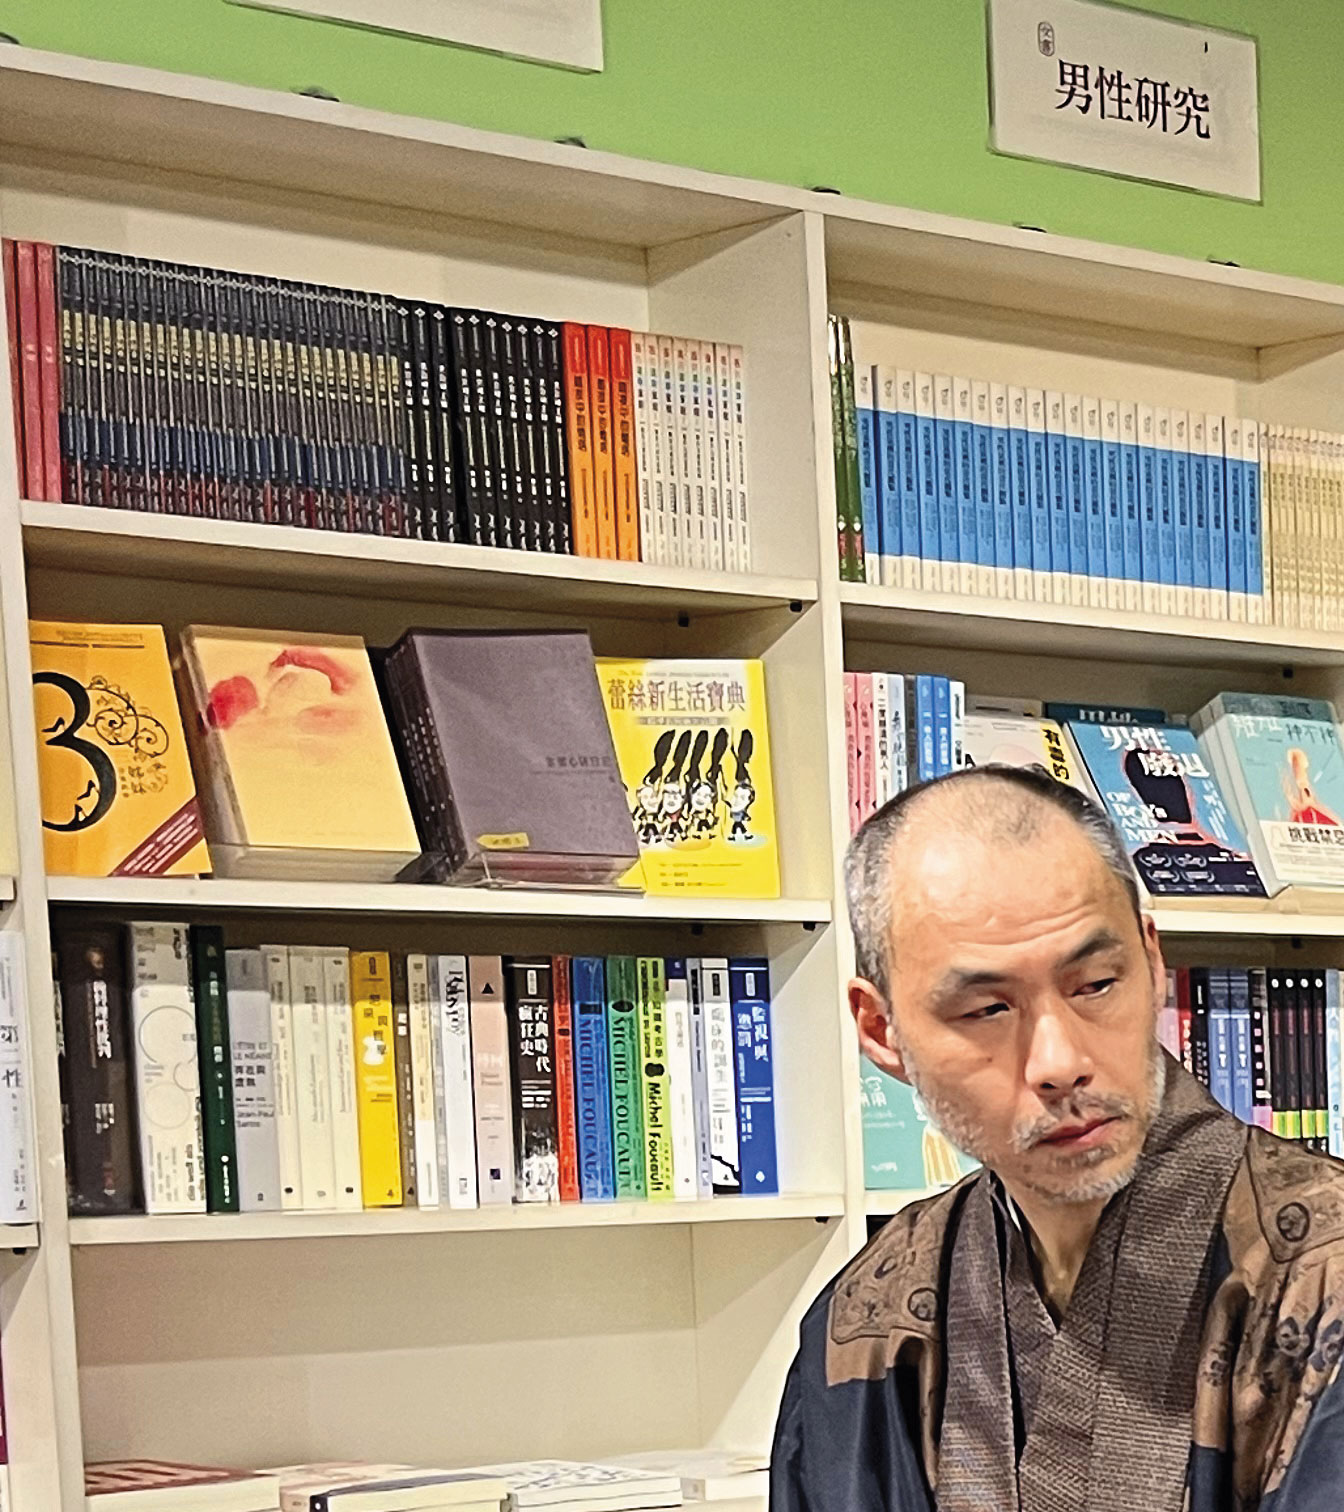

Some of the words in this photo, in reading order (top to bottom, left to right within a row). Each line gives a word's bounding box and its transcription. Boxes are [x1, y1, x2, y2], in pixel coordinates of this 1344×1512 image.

[1054, 58, 1212, 140] 男性研究
[606, 677, 748, 713] 蕾絲新生活寶典
[1125, 828, 1178, 845] MEN
